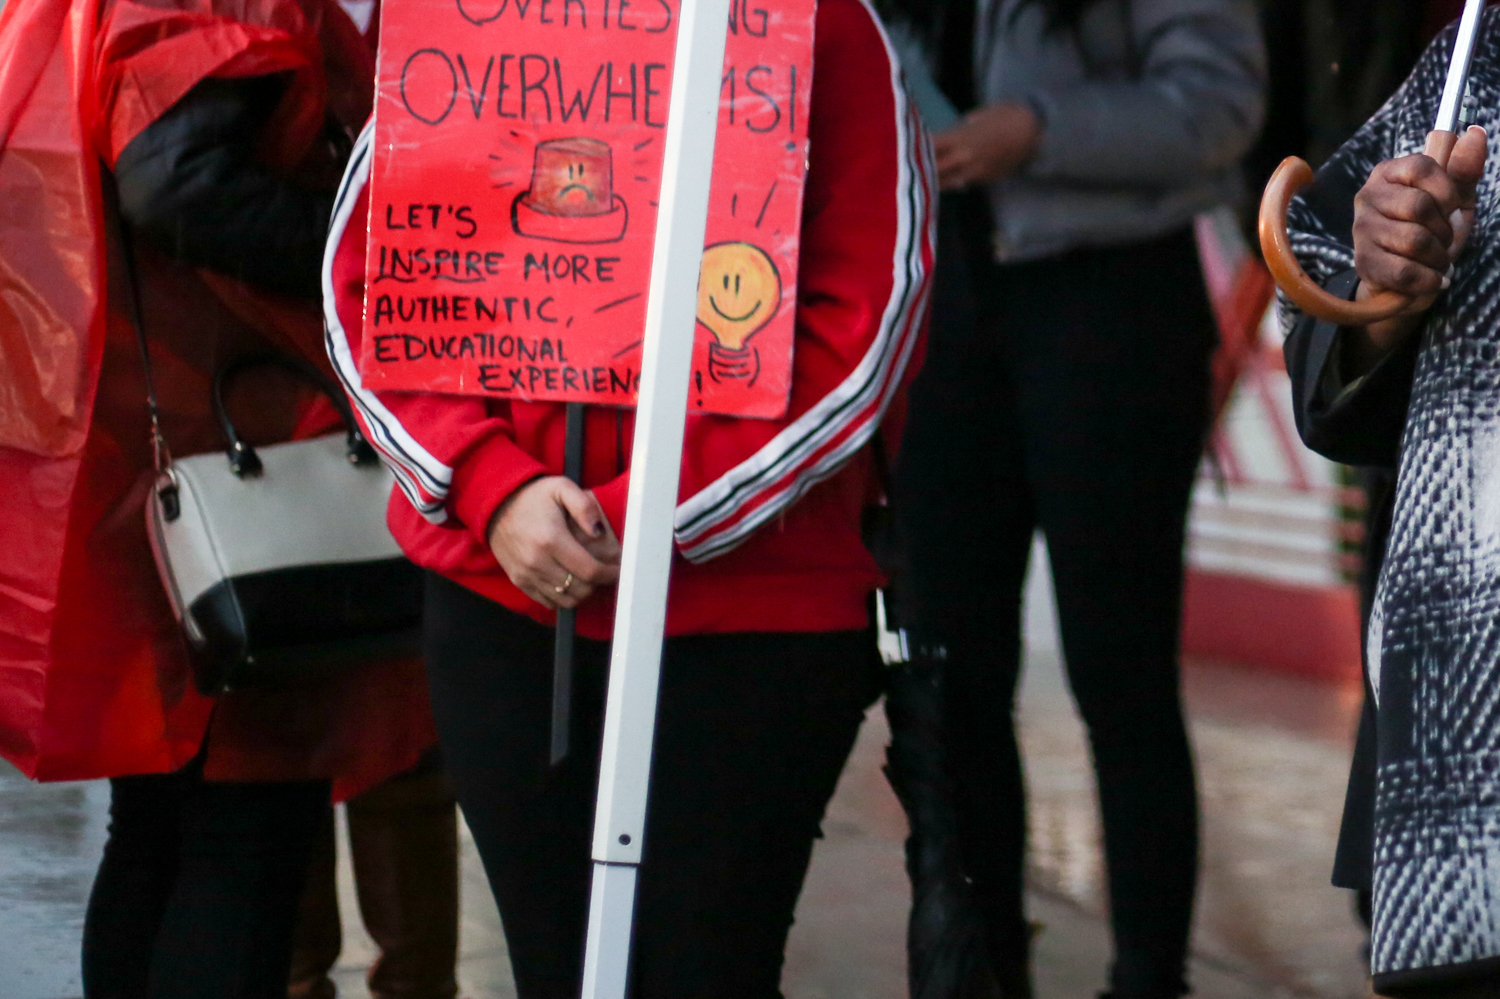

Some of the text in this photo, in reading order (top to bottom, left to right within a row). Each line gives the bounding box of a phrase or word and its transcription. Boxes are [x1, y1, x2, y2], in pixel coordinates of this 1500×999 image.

[386, 204, 477, 238] LET'S
[374, 247, 621, 283] INSPIRE MORE
[373, 294, 575, 328] AUTHENTIC,
[374, 334, 568, 363] EDUCATIONAL
